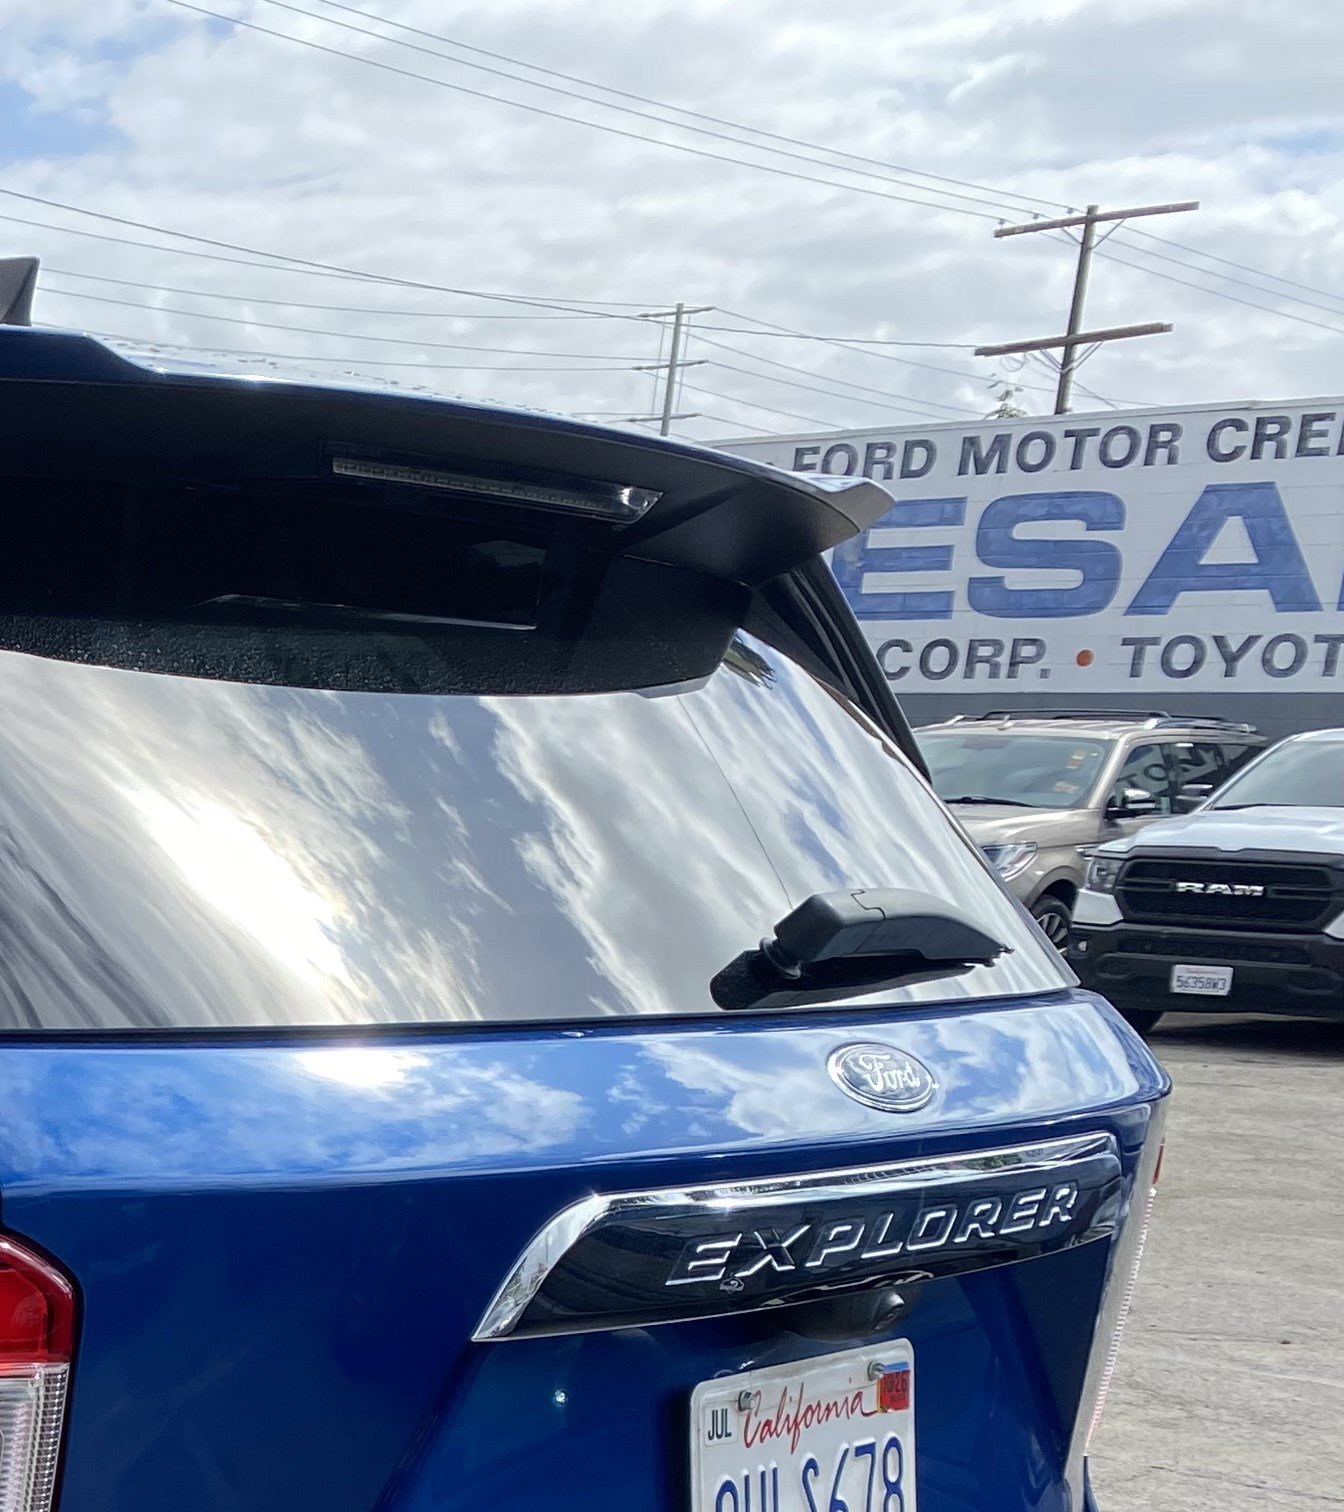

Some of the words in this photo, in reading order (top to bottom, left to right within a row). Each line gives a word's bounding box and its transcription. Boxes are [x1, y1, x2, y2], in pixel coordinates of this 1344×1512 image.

[792, 439, 938, 480] FORD
[957, 422, 1184, 476] MOTOR
[1206, 411, 1344, 463] CRE
[830, 480, 1344, 622] ESA
[875, 637, 1052, 681] CORP.
[1176, 881, 1265, 897] RAM
[858, 1053, 921, 1092] Ford
[665, 1182, 1079, 1287] EXPLORER
[707, 1407, 732, 1441] JUL
[743, 1378, 878, 1455] California
